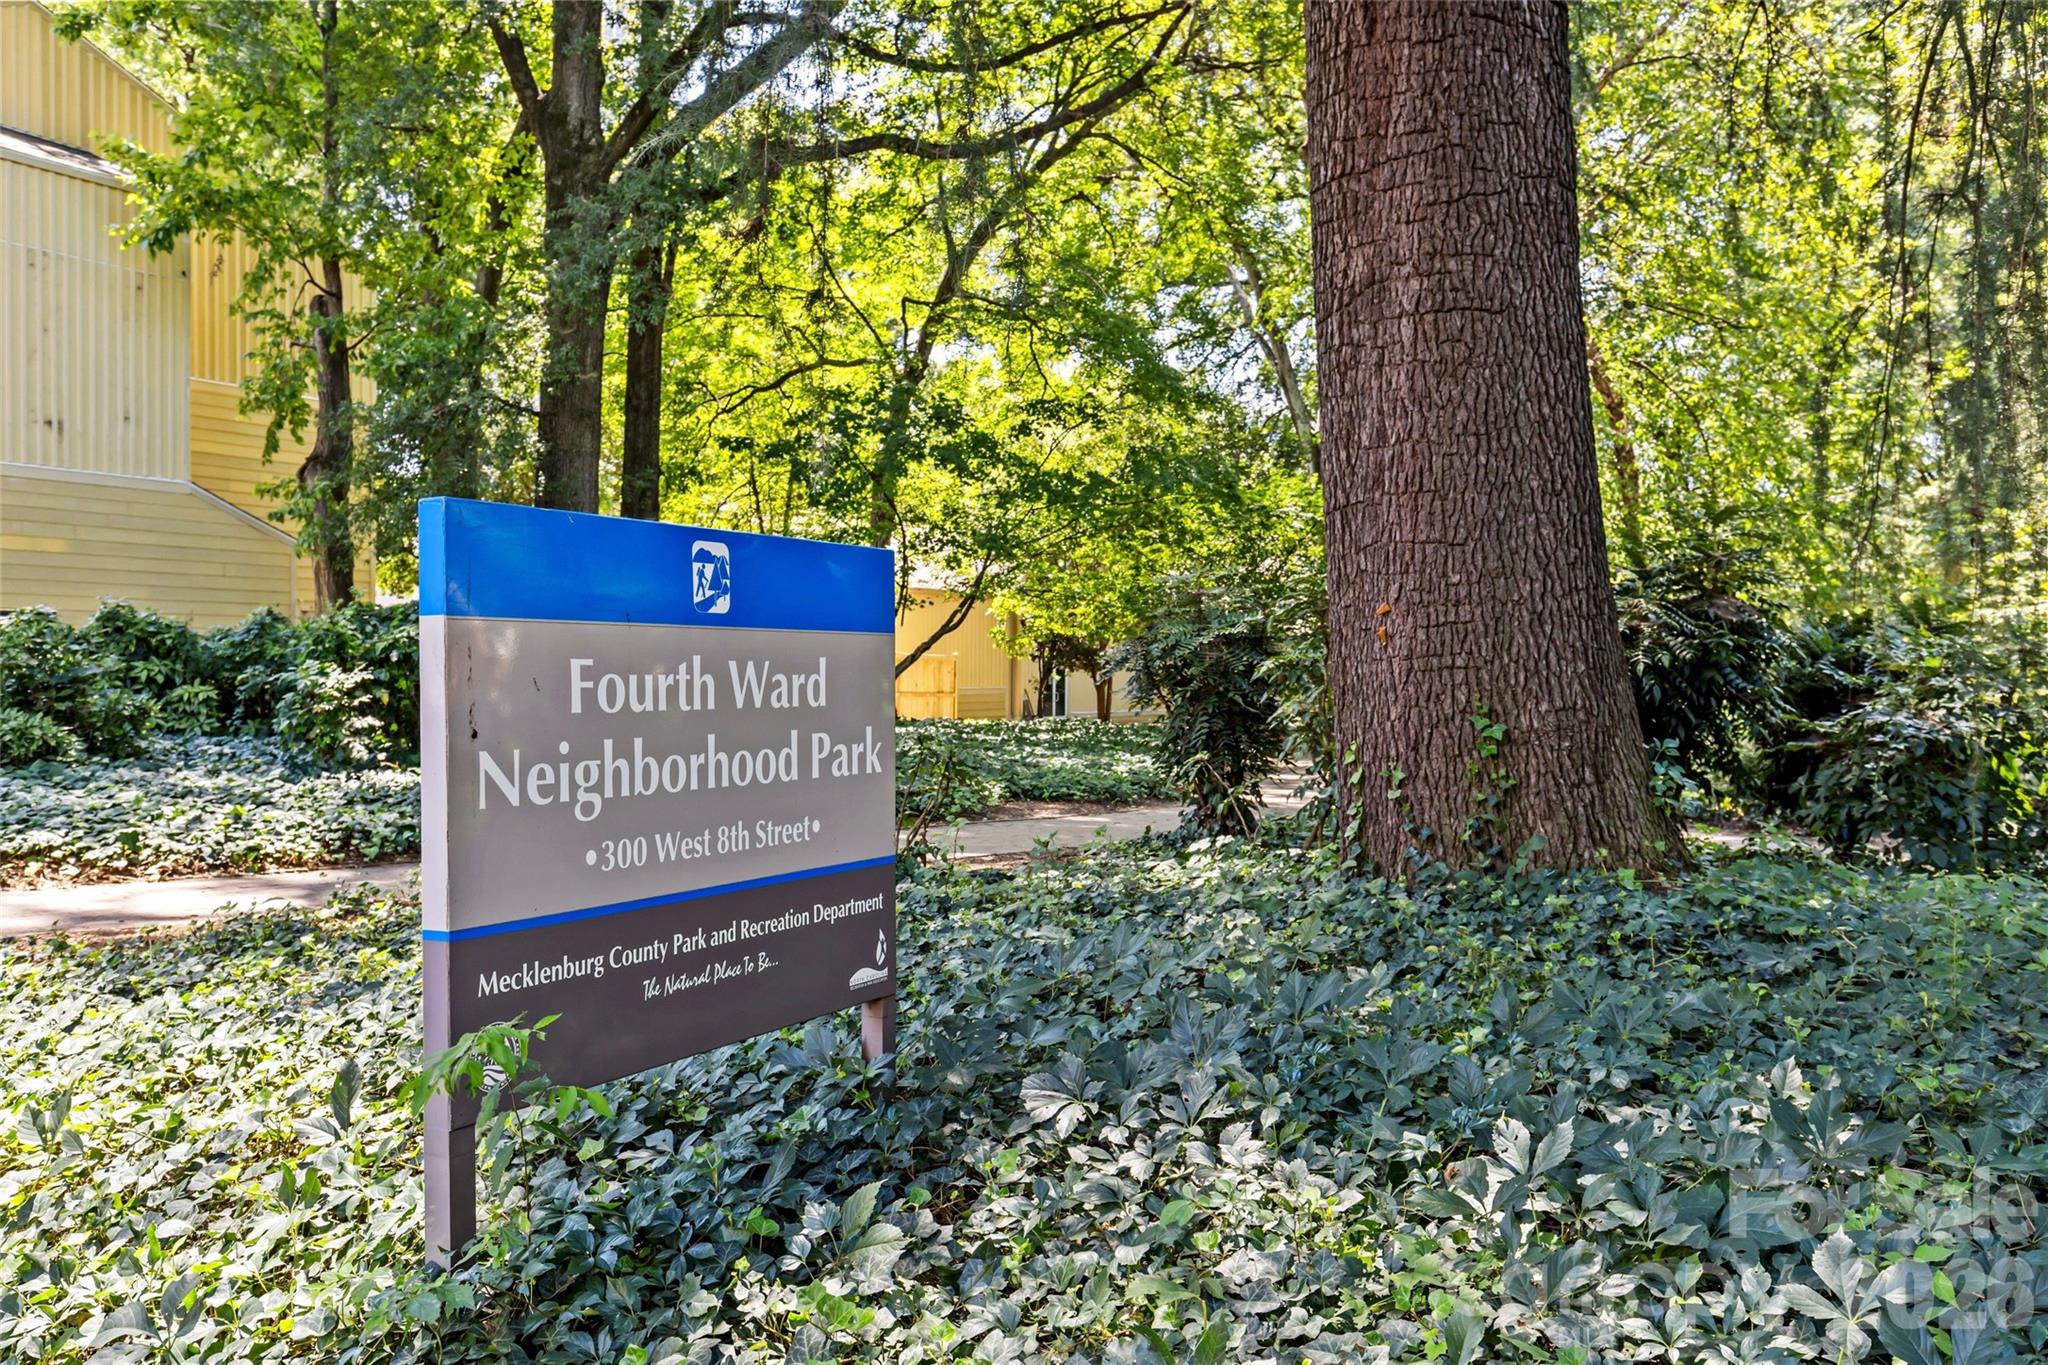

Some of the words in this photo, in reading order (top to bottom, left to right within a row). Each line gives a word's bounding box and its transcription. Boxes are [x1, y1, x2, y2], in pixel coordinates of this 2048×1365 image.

[570, 655, 715, 714] Fourth
[728, 657, 827, 709] Ward
[479, 730, 798, 822] Neighborhood
[812, 726, 882, 779] Park
[655, 830, 711, 863] West
[718, 822, 750, 854] 8th
[477, 953, 604, 998] Mecklenburg
[609, 938, 669, 970] County
[673, 928, 706, 956] Park
[710, 920, 737, 947] and
[740, 908, 810, 940] Recreation
[813, 892, 884, 925] Department
[642, 976, 662, 1001] The
[664, 963, 712, 997] Natural
[713, 960, 742, 985] Place
[743, 955, 755, 976] To
